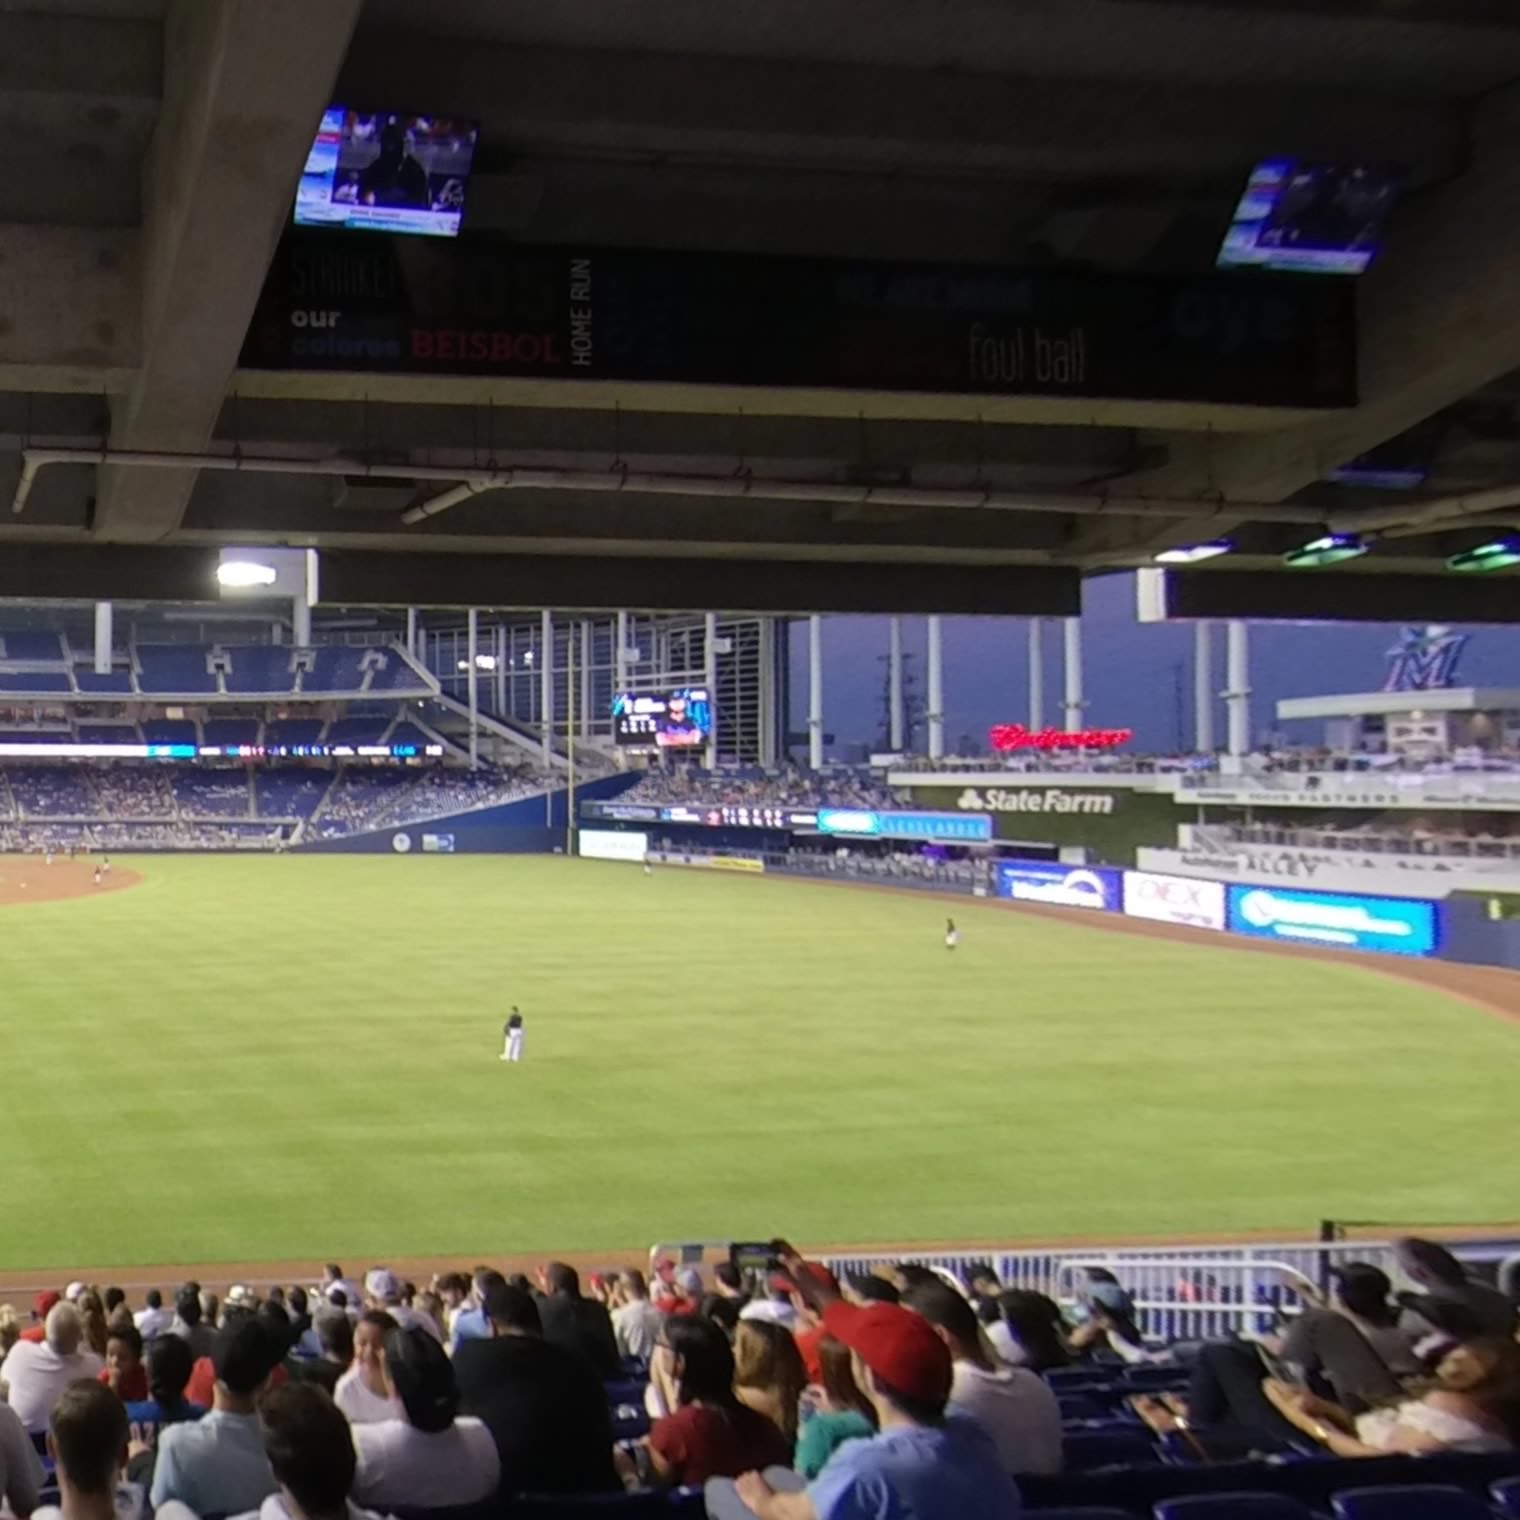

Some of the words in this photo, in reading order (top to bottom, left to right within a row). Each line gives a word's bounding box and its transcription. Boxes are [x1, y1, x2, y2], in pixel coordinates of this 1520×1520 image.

[570, 259, 590, 301] RUN
[291, 308, 341, 329] our
[571, 308, 592, 366] HOME
[411, 329, 561, 364] BEISBOL
[969, 321, 1024, 381] foul
[1035, 326, 1086, 384] ball
